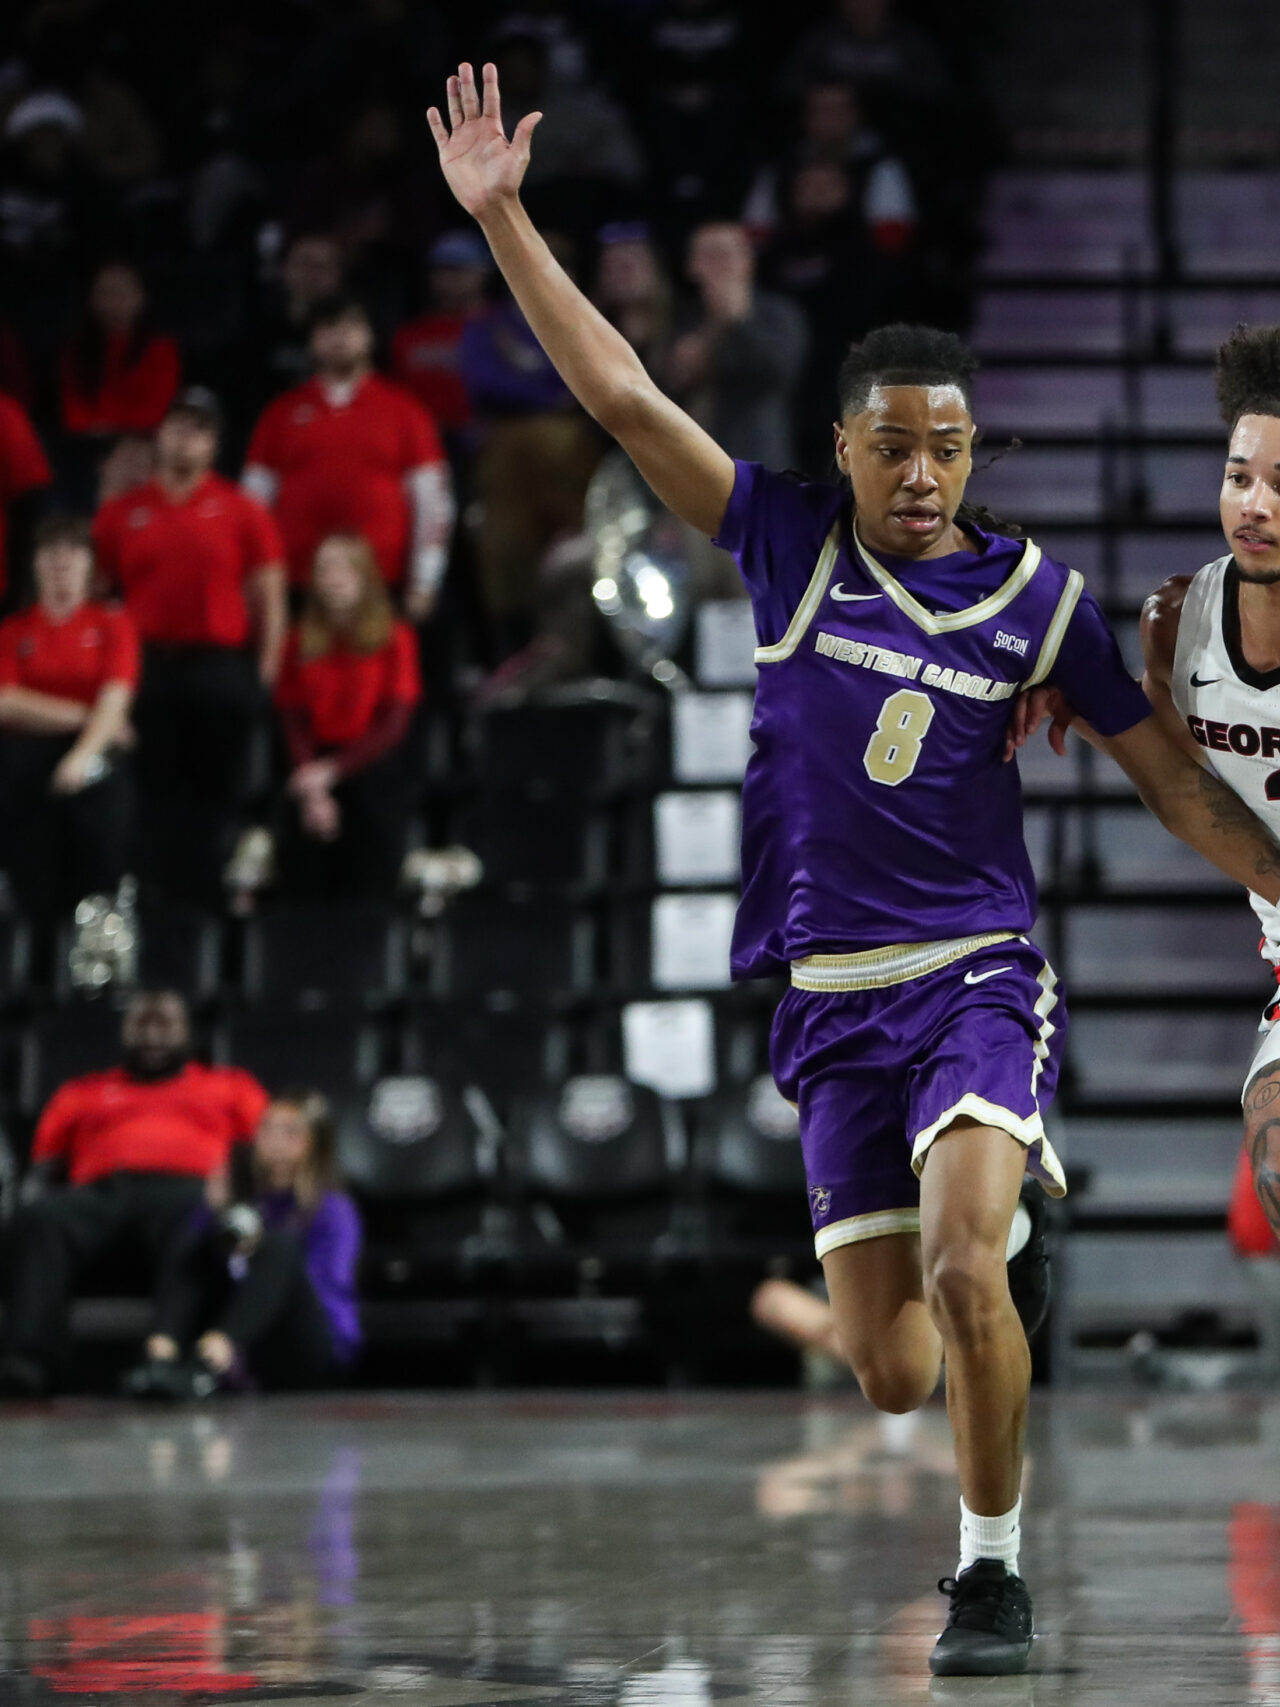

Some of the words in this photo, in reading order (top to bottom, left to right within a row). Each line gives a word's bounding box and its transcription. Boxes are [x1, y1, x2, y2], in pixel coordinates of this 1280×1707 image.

[814, 631, 923, 680] WESTERN
[920, 663, 1019, 701] CAROLIN
[862, 688, 936, 787] 8
